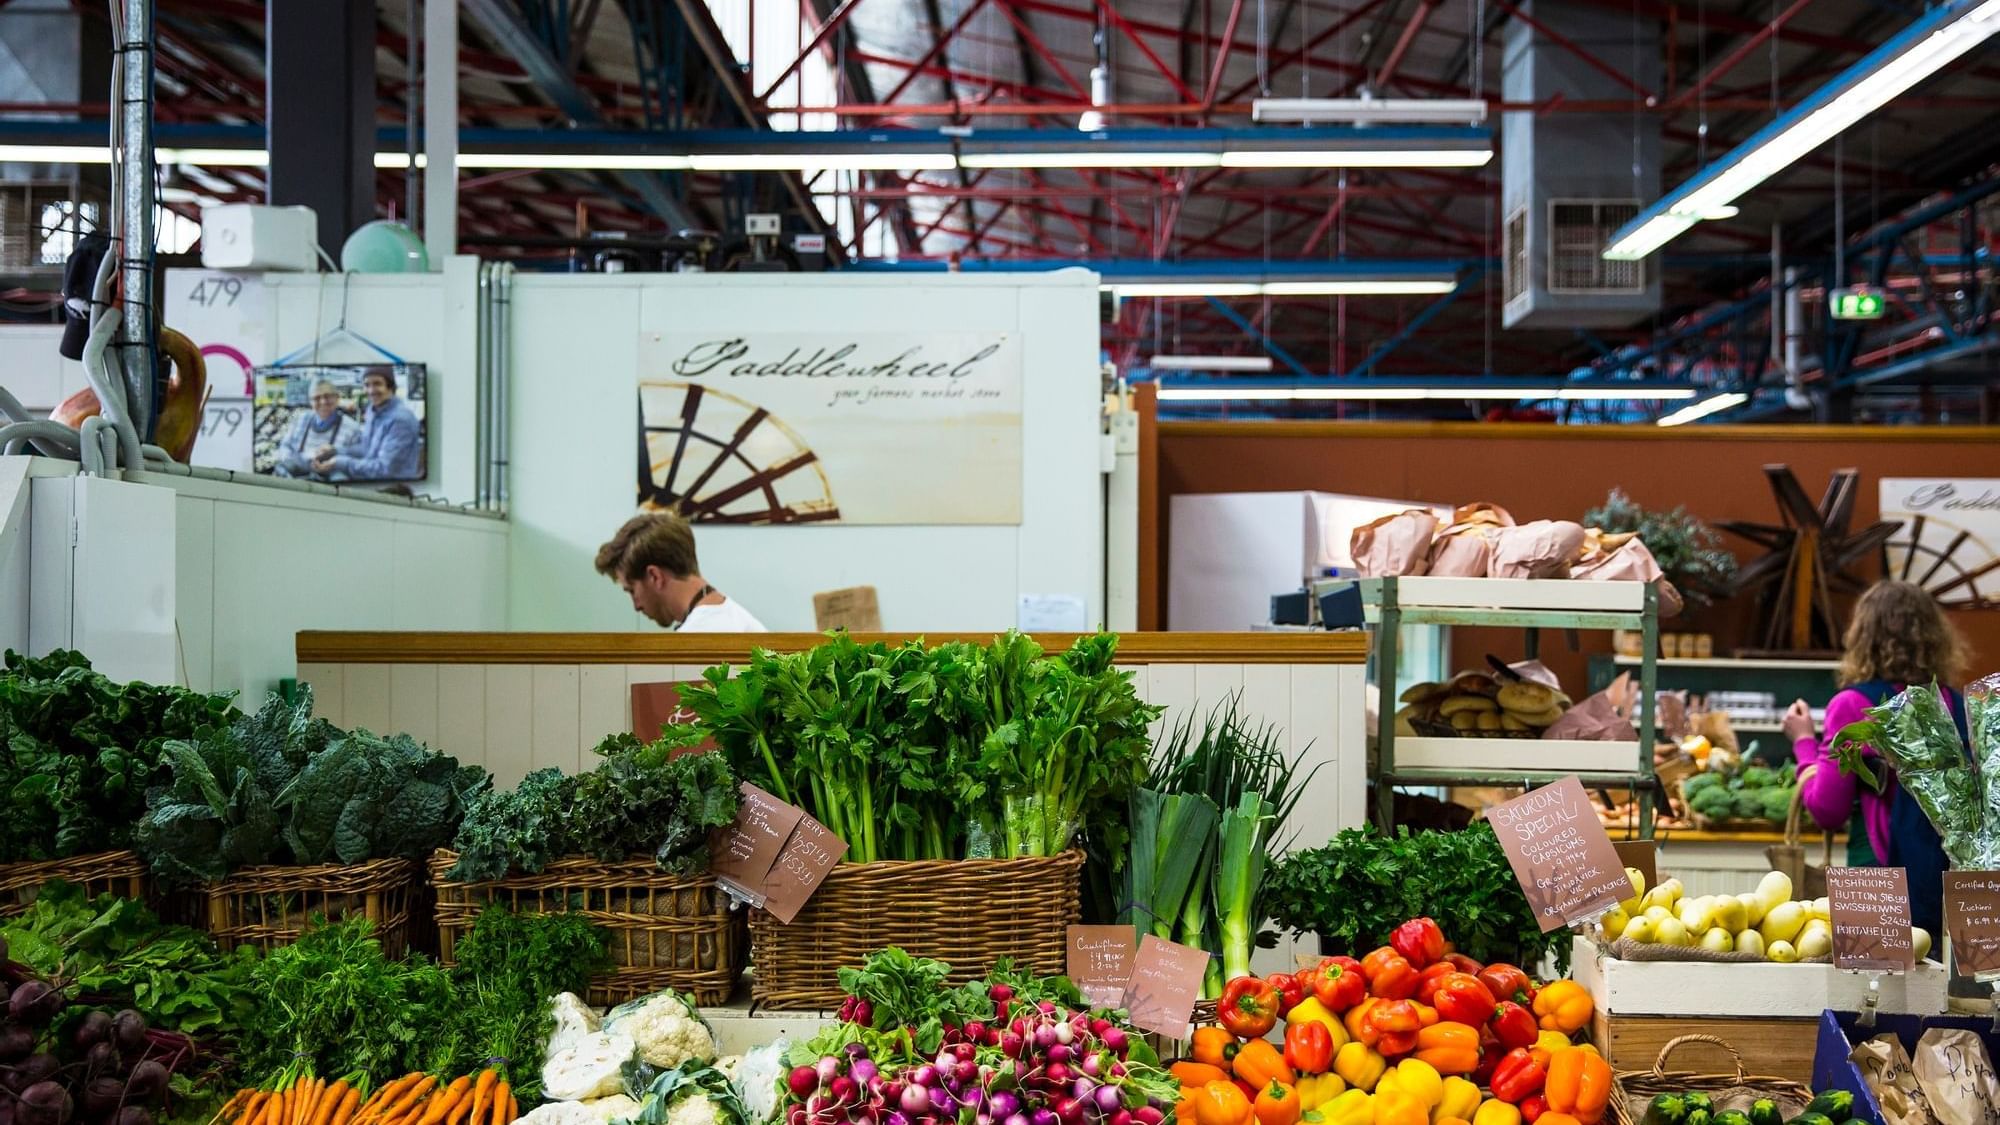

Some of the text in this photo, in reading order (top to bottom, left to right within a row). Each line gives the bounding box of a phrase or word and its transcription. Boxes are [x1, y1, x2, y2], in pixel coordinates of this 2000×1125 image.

[672, 338, 1000, 377] Paddlewheel
[200, 408, 242, 437] 79
[1497, 786, 1564, 826] SATURDAY
[1516, 801, 1578, 840] SPECIAL
[801, 815, 825, 838] LERY
[1521, 827, 1577, 857] COLOURED
[1532, 836, 1587, 865] CAPSICUMS
[1536, 870, 1571, 889] GROWN
[1827, 867, 1900, 879] ANNE-MARIE'S
[1829, 879, 1894, 889] MUSHROOMS
[1544, 897, 1582, 917] ORGANIC
[1592, 876, 1628, 897] PRACTICE
[1570, 885, 1584, 895] VIC
[1835, 890, 1877, 901] BUTTON
